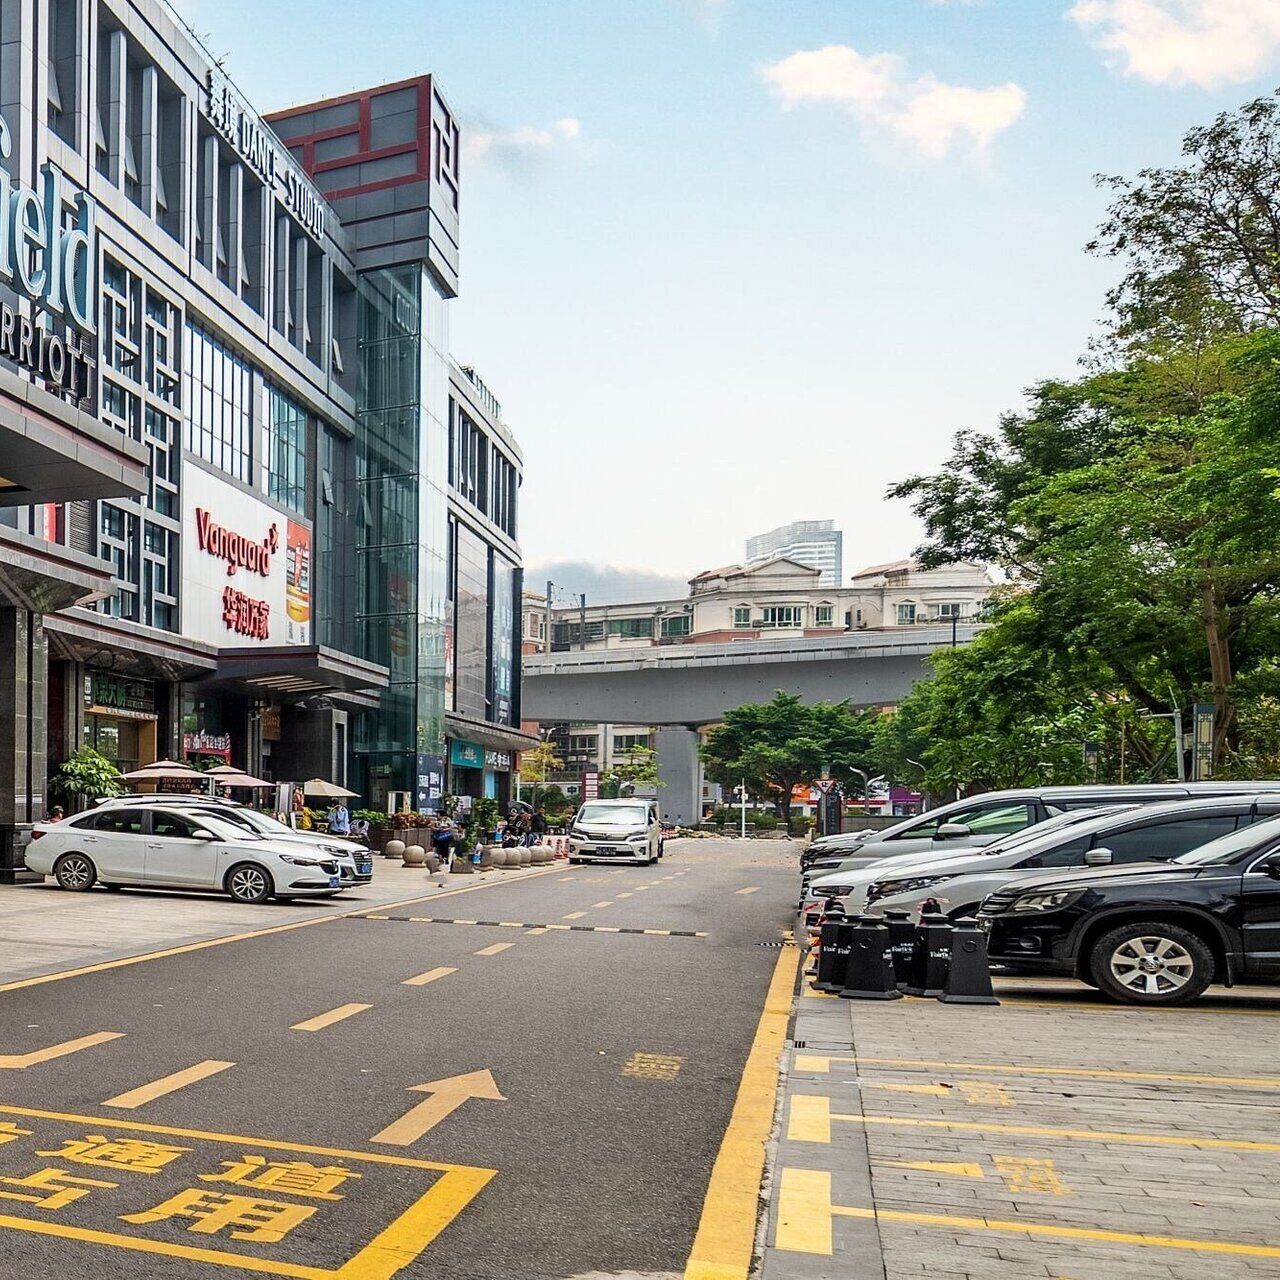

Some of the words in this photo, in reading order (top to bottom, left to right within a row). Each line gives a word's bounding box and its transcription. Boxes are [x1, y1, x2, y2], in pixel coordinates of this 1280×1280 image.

[240, 112, 278, 189] DANCE
[286, 170, 324, 240] STUDIO
[195, 507, 272, 577] Vanguard
[222, 585, 270, 641] 华润万家
